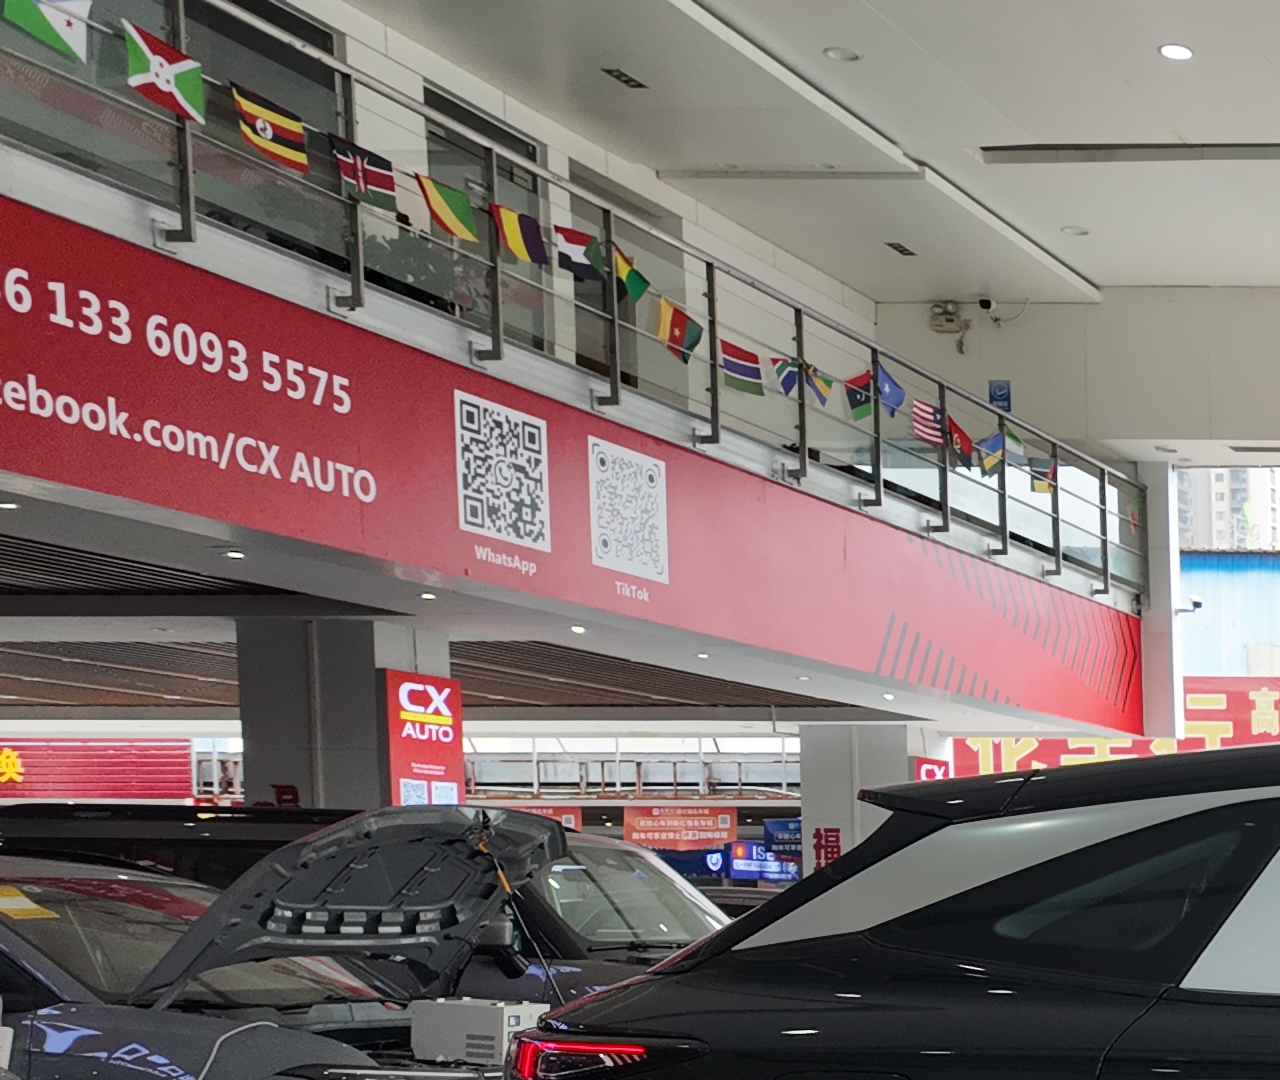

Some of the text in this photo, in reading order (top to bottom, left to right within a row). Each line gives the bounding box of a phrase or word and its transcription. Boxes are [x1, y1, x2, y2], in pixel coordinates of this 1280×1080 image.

[0, 267, 351, 414] 6 133 6093 5575
[0, 373, 377, 503] ebook.com/CX AUTO
[474, 544, 537, 577] WhatsApp
[615, 580, 650, 602] TikTok
[399, 681, 452, 716] CX
[402, 721, 454, 743] AUTO
[813, 827, 841, 873] 福
